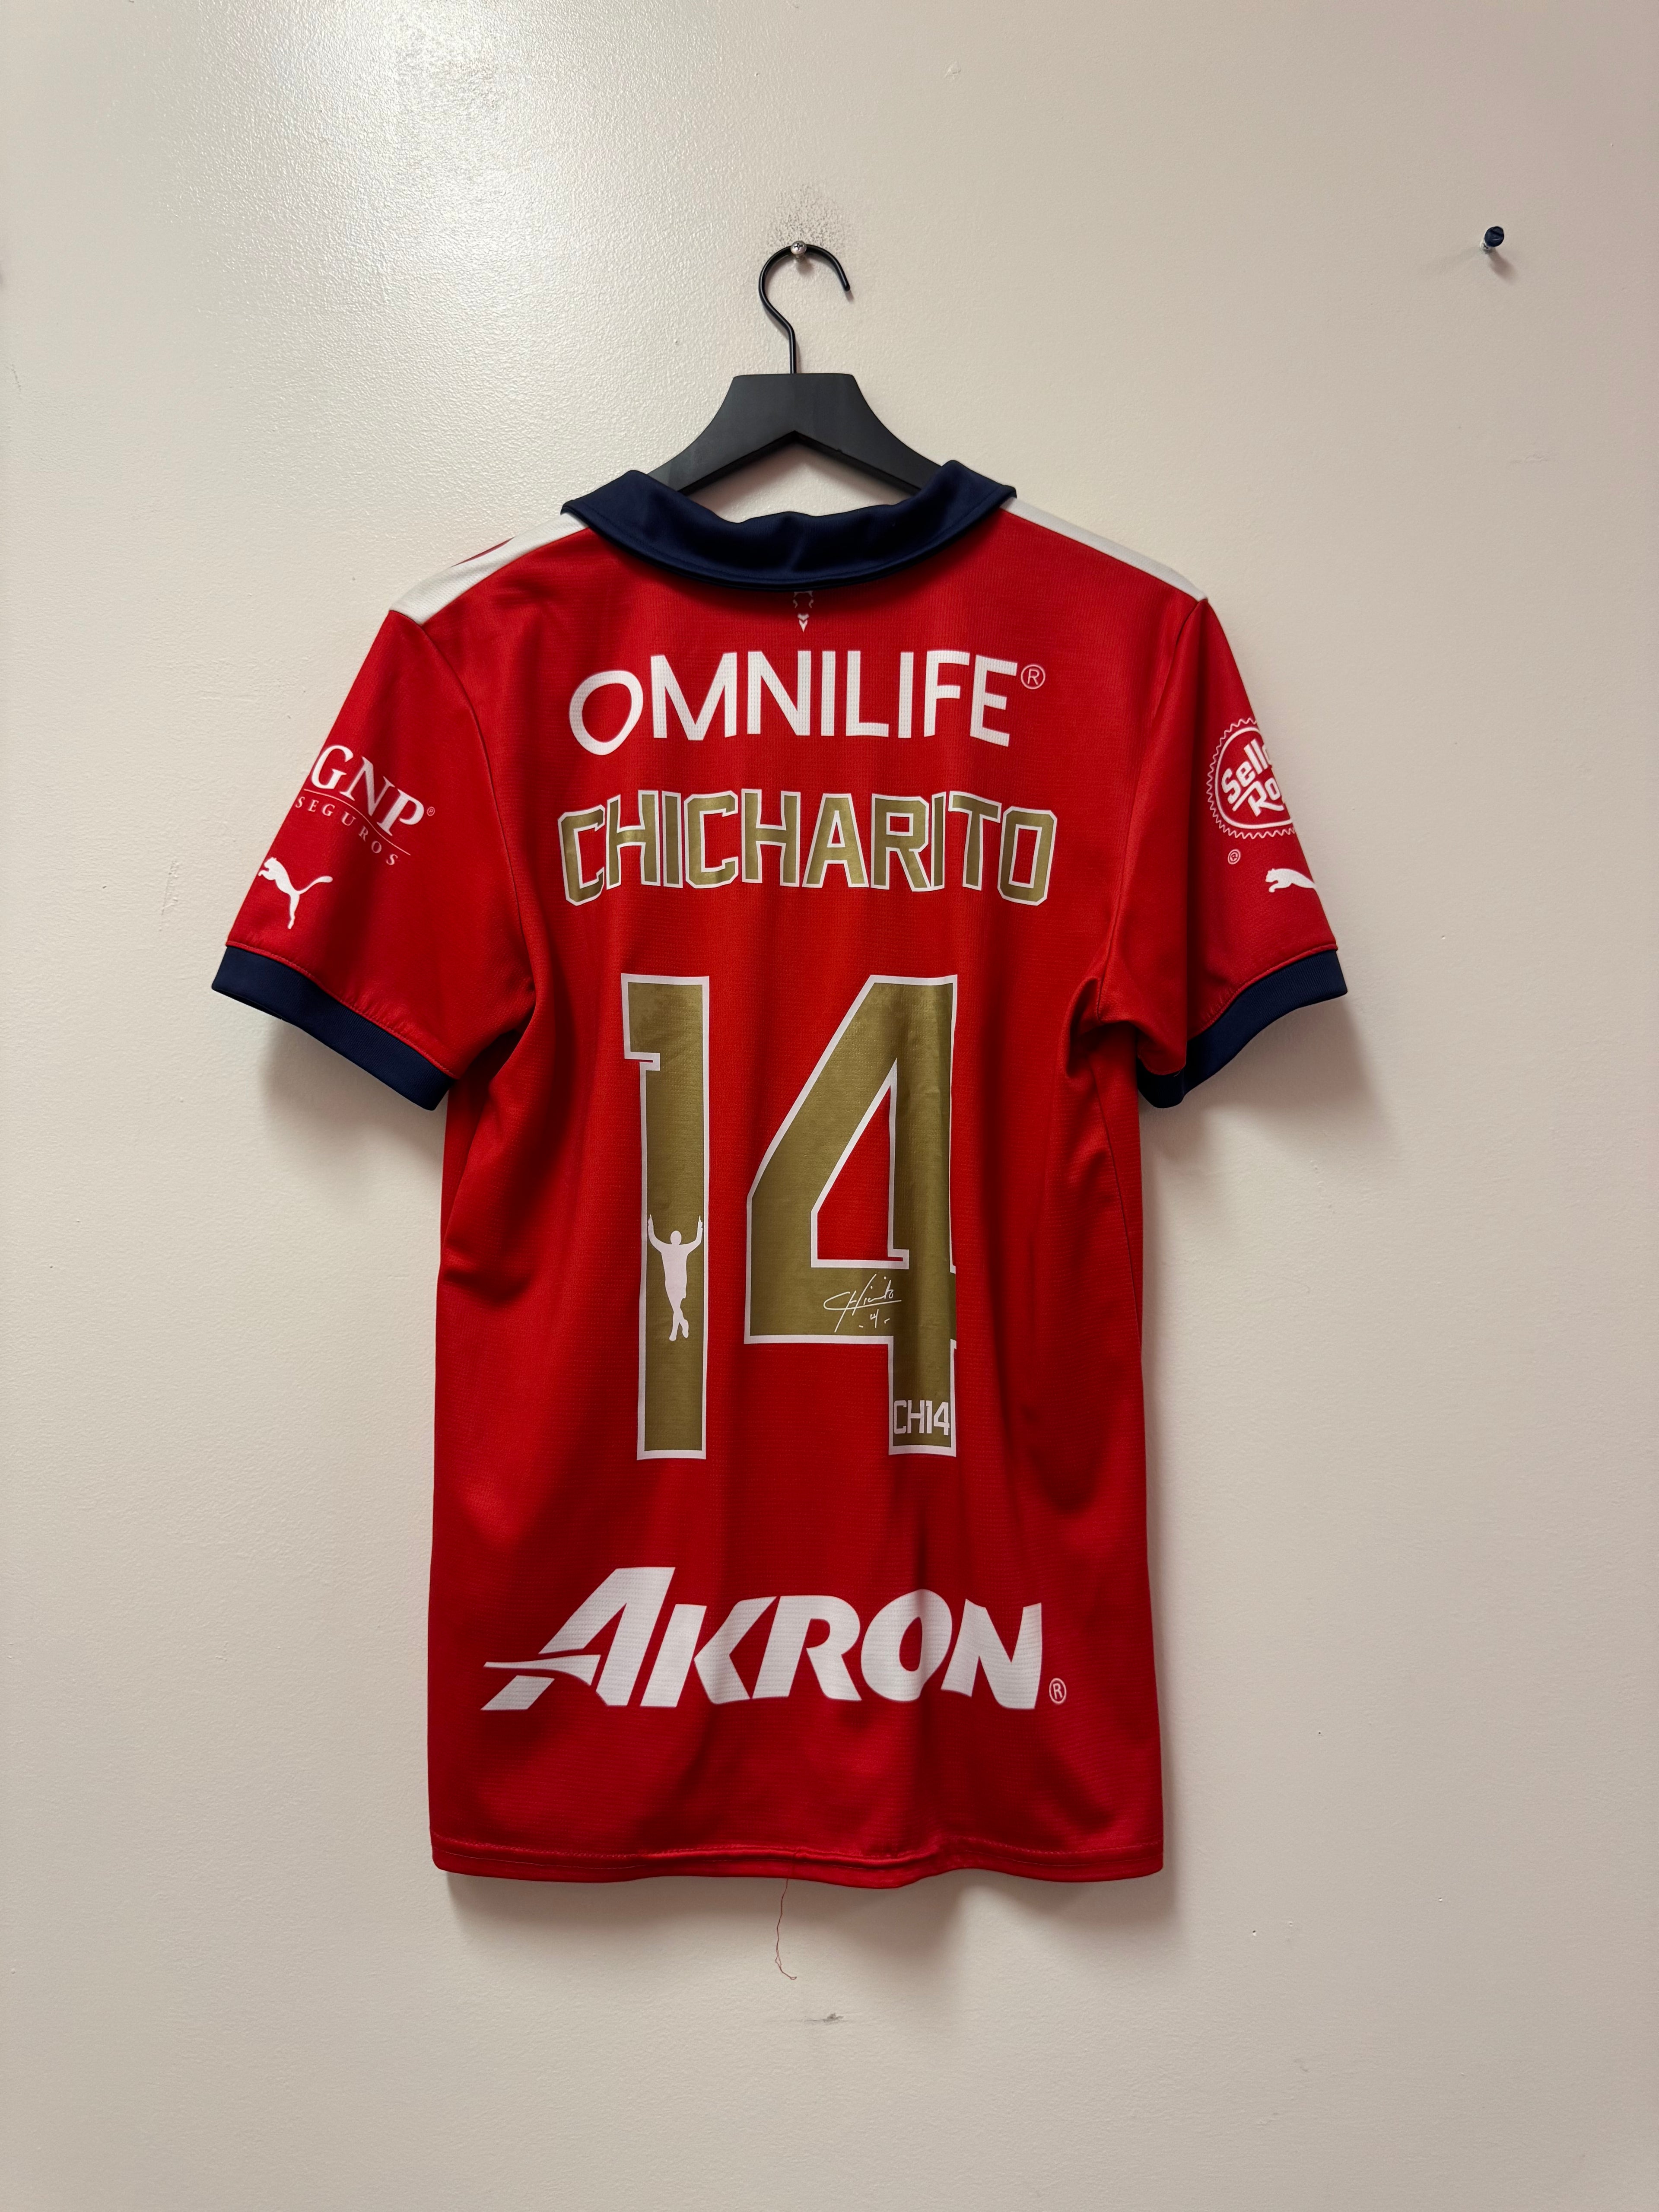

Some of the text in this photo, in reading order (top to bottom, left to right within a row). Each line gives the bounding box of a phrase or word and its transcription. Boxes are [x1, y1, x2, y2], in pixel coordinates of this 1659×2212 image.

[295, 796, 398, 865] SEGUROS
[558, 788, 1057, 906] CHICHARITO
[621, 974, 958, 1460] 14
[893, 1399, 950, 1436] CH14
